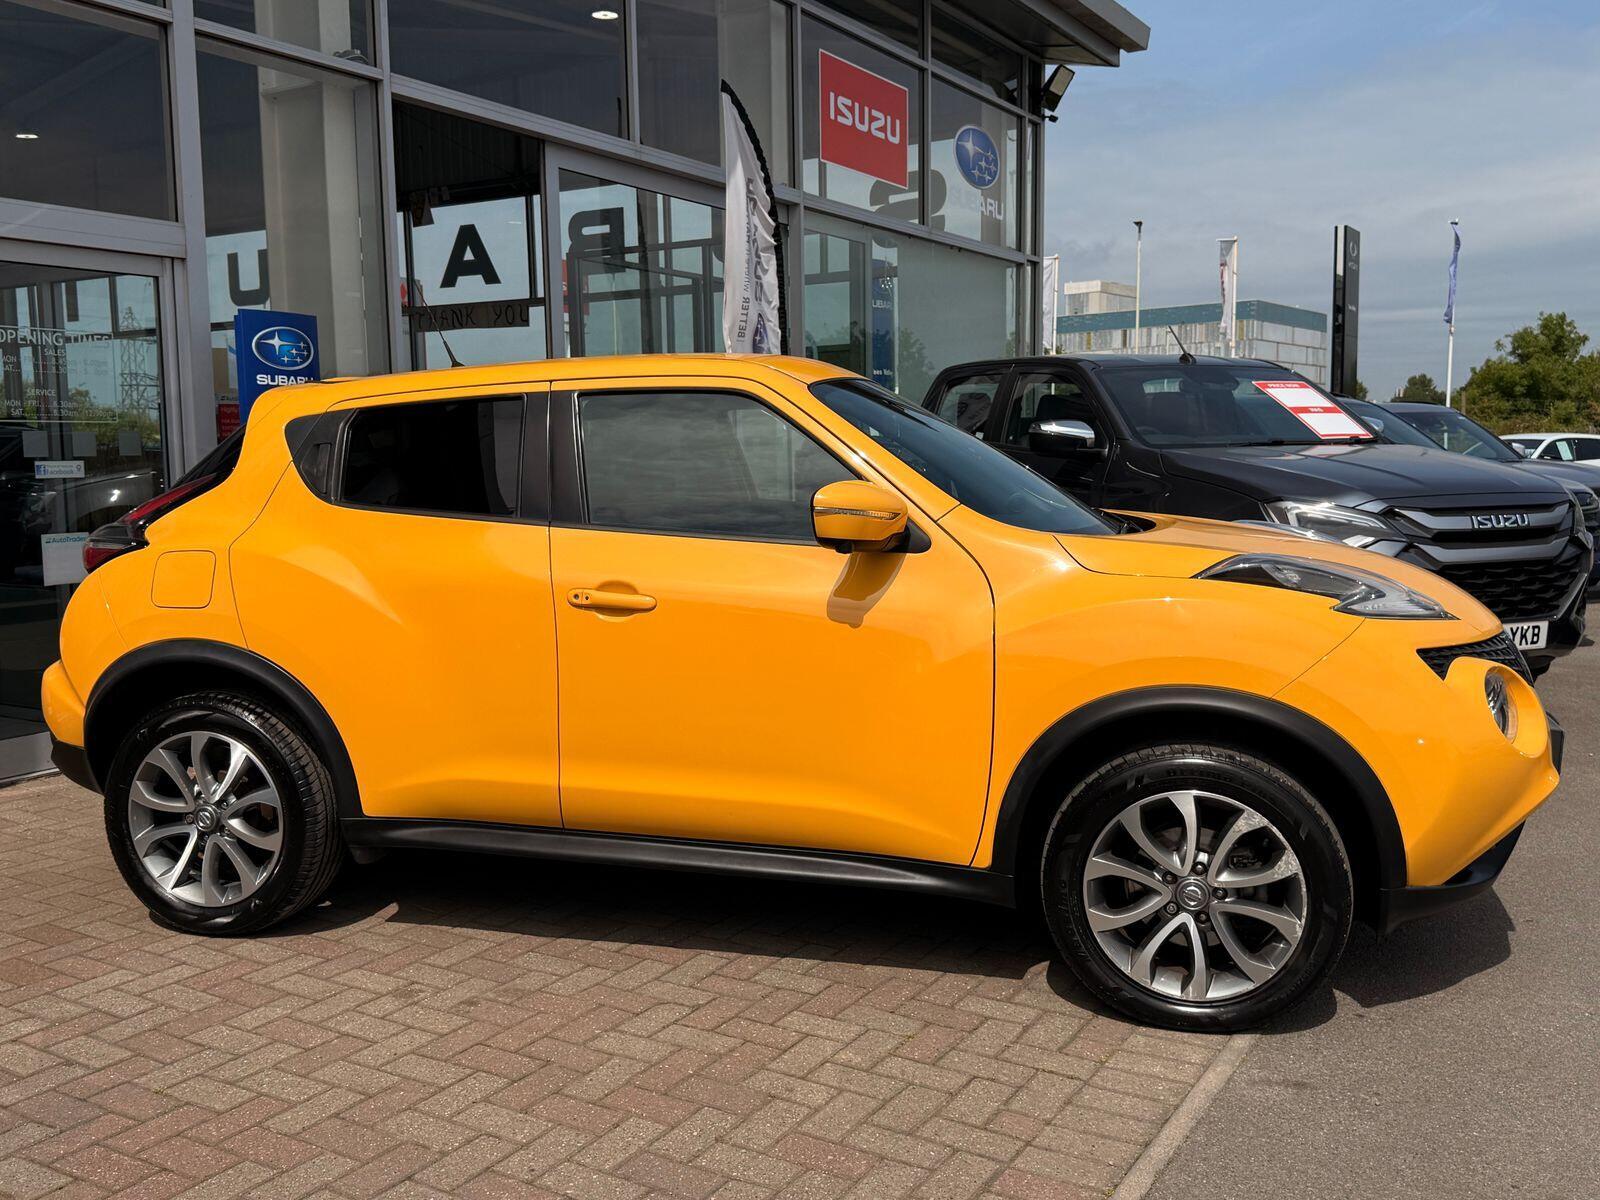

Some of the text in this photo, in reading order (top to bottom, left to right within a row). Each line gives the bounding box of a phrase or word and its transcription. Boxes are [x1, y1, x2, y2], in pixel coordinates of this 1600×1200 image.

[829, 91, 900, 145] ISUZU
[0, 329, 64, 346] OPENING
[1471, 514, 1529, 529] ISUZU
